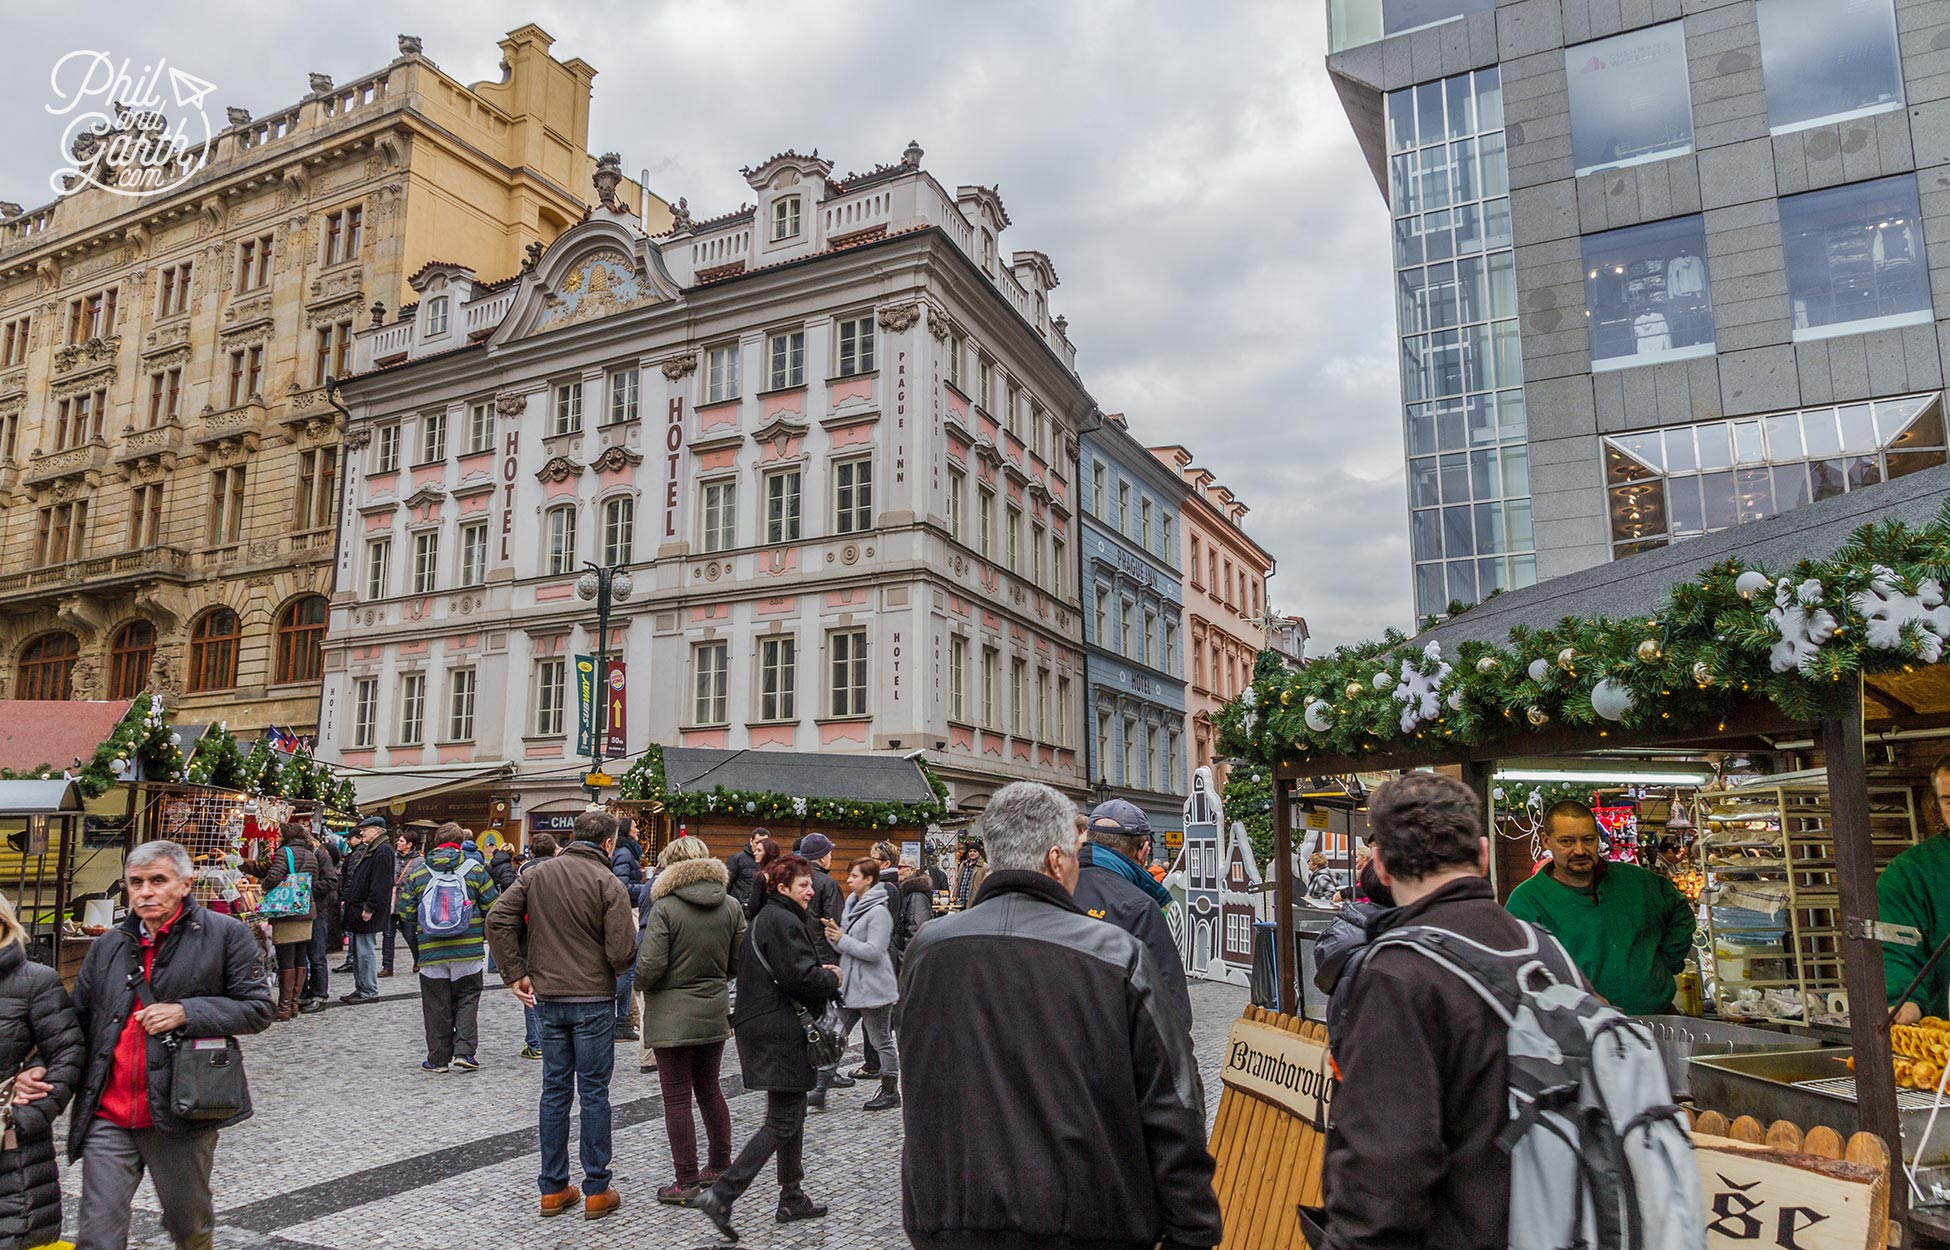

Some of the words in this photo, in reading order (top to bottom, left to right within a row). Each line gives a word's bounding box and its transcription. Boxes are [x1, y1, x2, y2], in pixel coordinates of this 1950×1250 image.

[666, 397, 682, 536] HOTEL
[896, 446, 904, 482] INN
[501, 431, 519, 560] HOTEL
[1117, 549, 1144, 582] PRAGUE
[1146, 564, 1158, 588] INN
[893, 633, 901, 701] HOTEL
[1131, 671, 1151, 695] HOTEL
[582, 673, 590, 727] SUBWAY
[270, 887, 290, 901] 30
